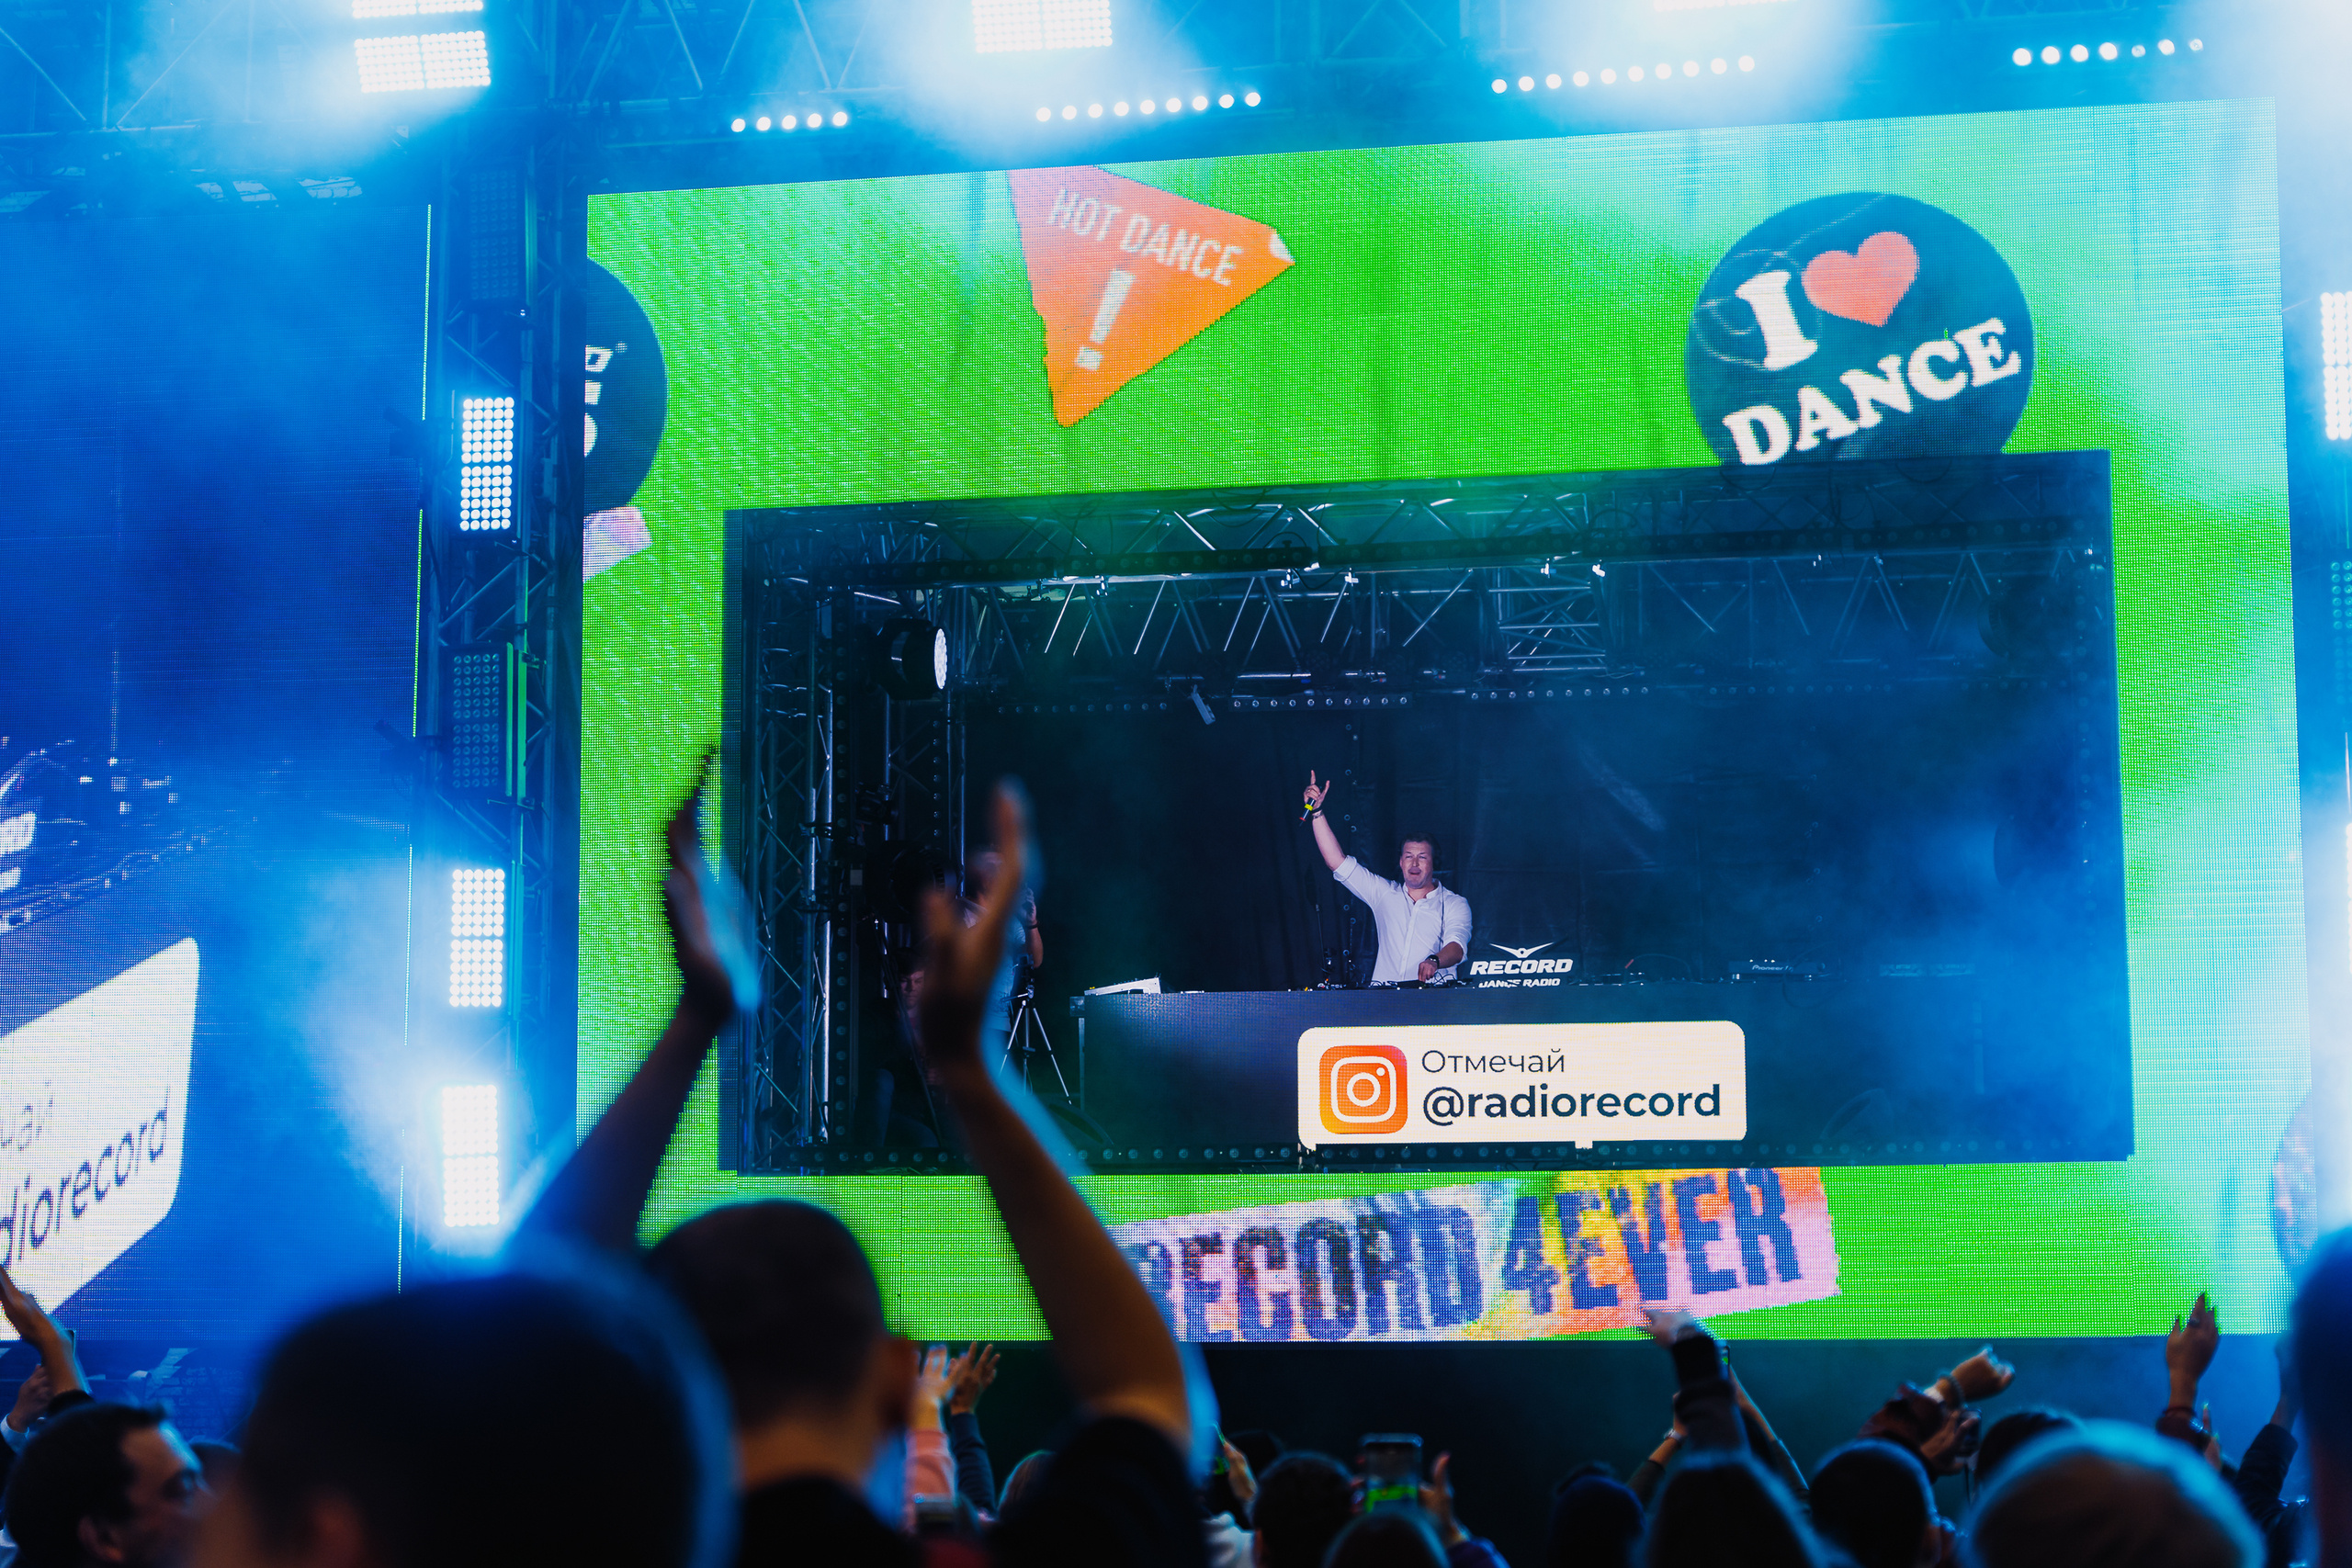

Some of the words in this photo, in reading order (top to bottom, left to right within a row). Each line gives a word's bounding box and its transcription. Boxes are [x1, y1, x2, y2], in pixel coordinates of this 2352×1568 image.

[1047, 187, 1124, 242] HOT
[1118, 212, 1244, 287] DANCE
[1736, 269, 1818, 371] I
[1722, 317, 2022, 466] DANCE
[1470, 958, 1574, 976] RECORD
[1522, 978, 1561, 988] RADIO
[1421, 1048, 1566, 1074] Отмечай
[1423, 1084, 1722, 1126] @radiorecord
[1501, 1168, 1801, 1315] 4EVER
